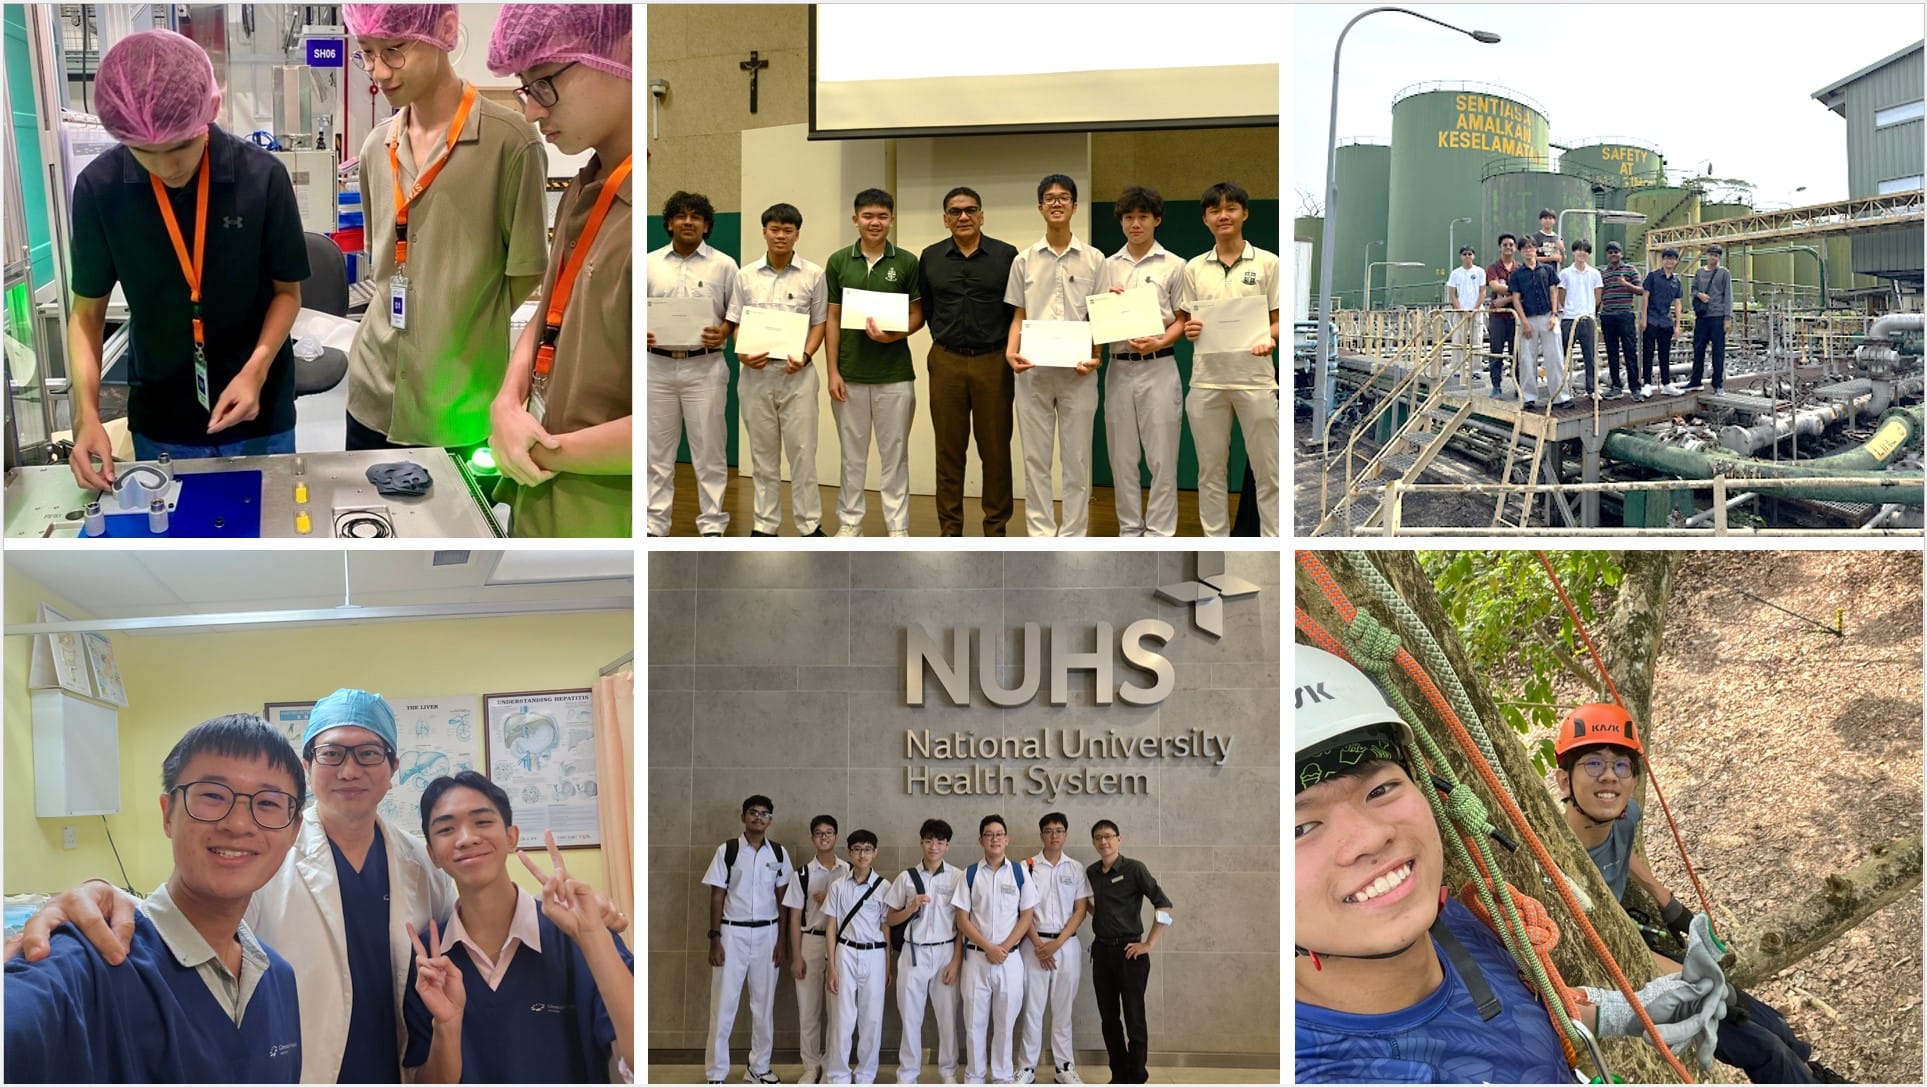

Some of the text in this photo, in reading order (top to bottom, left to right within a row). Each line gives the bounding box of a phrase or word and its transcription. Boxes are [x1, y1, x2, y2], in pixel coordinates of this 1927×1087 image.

[313, 49, 336, 58] SH06
[1456, 95, 1532, 126] SENTIASA
[1456, 113, 1531, 144] AMALKAN
[1602, 146, 1648, 164] SAFETY
[1619, 162, 1634, 176] AT
[906, 618, 1176, 708] NUHS
[497, 697, 553, 705] UNDERSTANDING
[907, 727, 1235, 766] National University
[907, 764, 1151, 804] Health System
